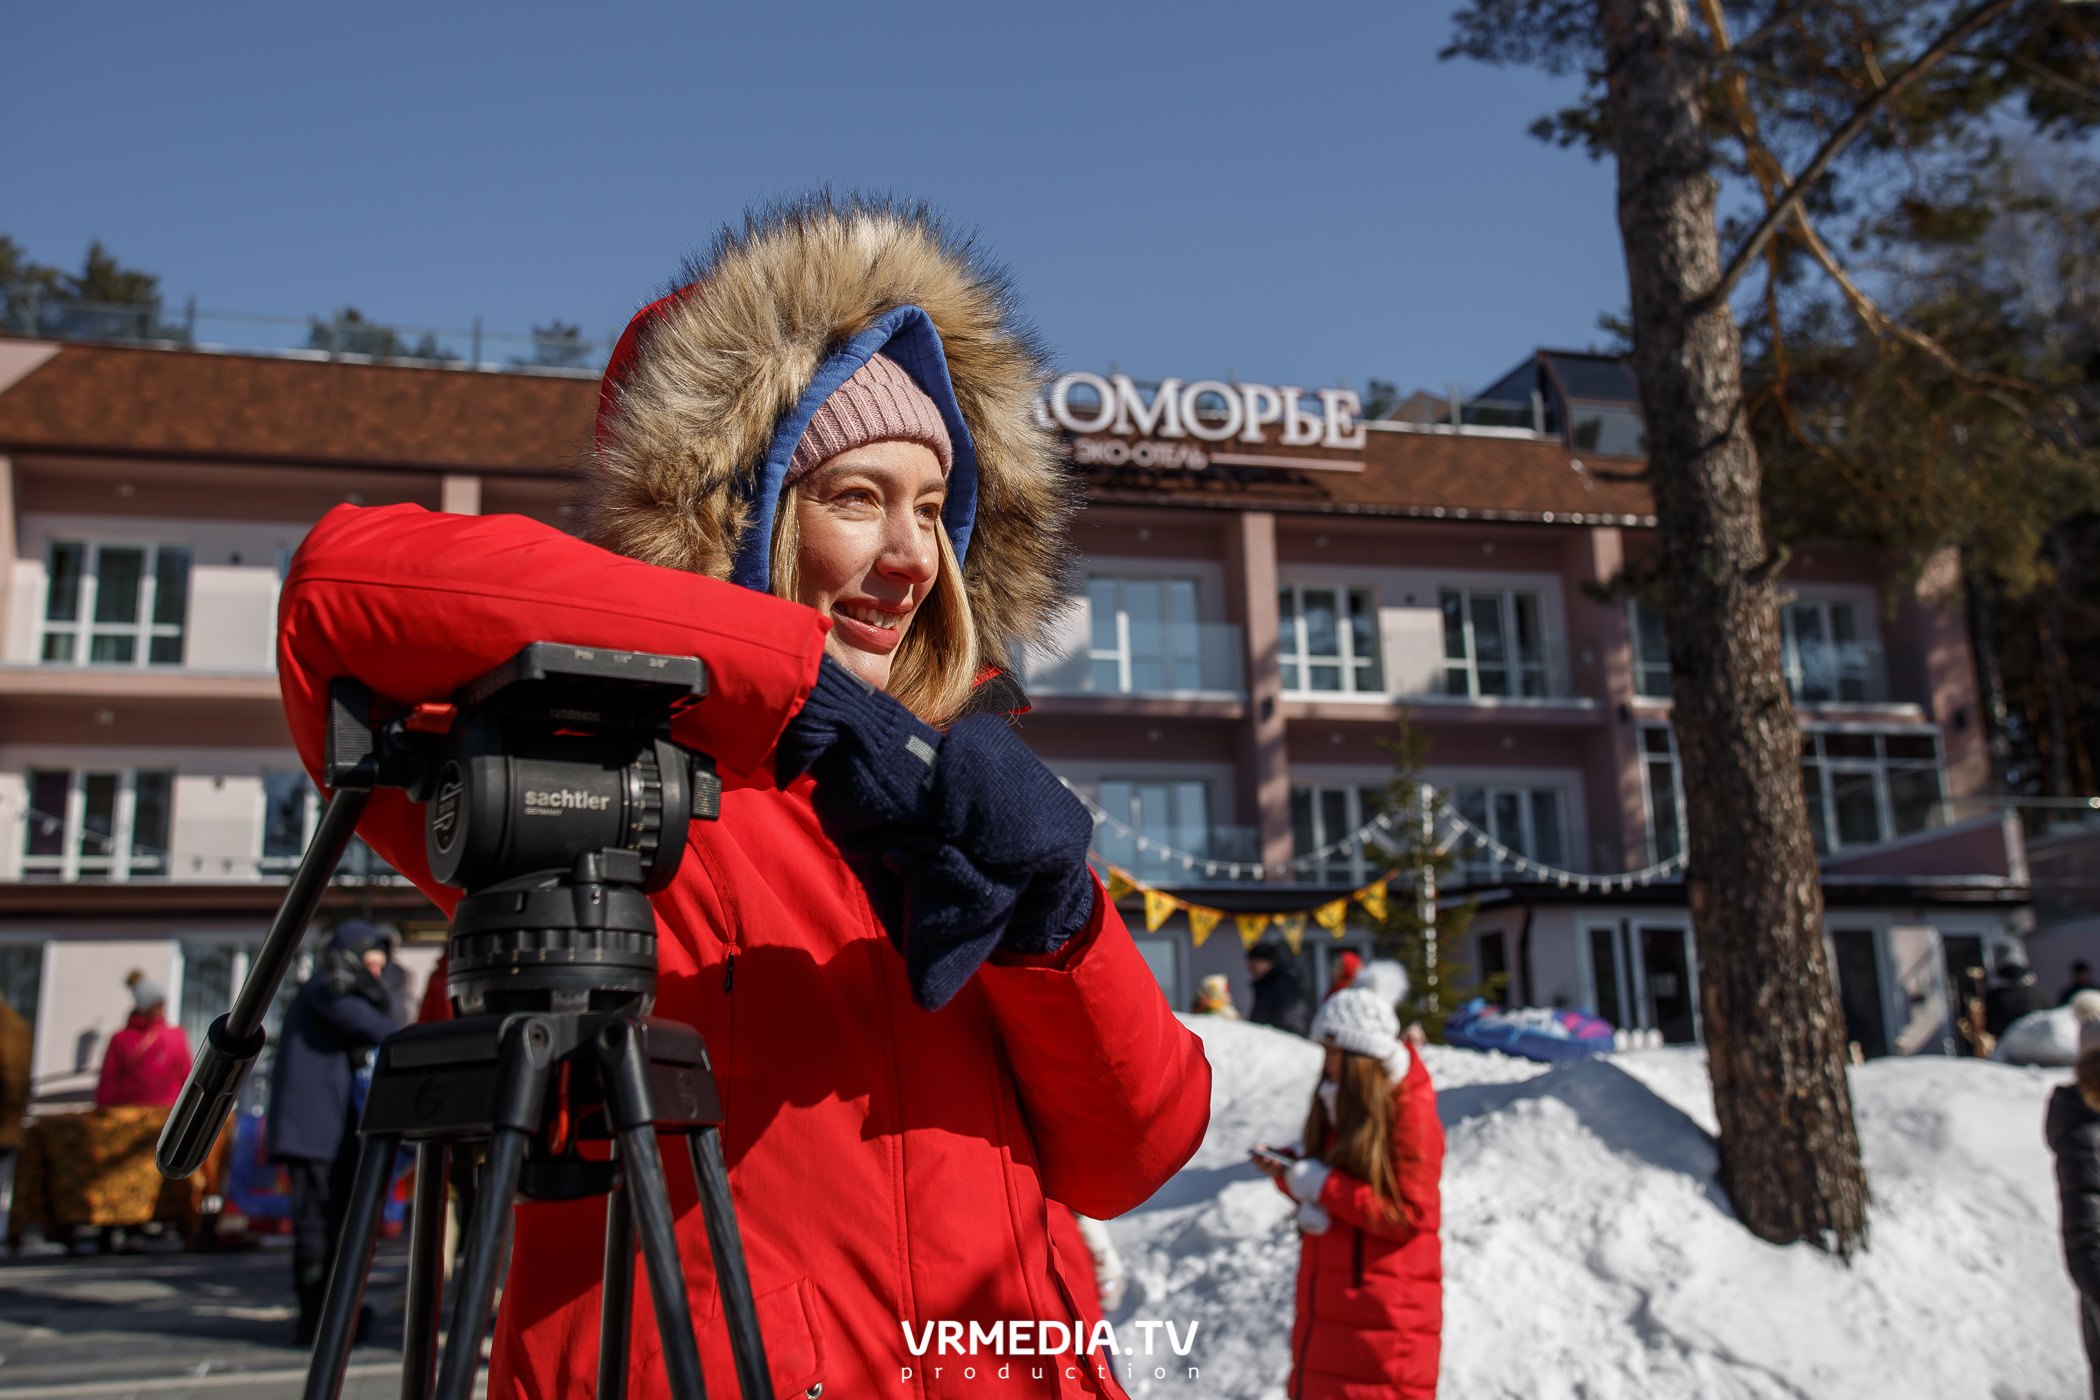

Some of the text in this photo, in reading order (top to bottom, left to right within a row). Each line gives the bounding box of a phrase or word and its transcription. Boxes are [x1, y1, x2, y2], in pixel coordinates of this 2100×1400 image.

[574, 648, 594, 661] PIN
[524, 789, 610, 810] sachtler
[524, 806, 562, 816] GERMANY
